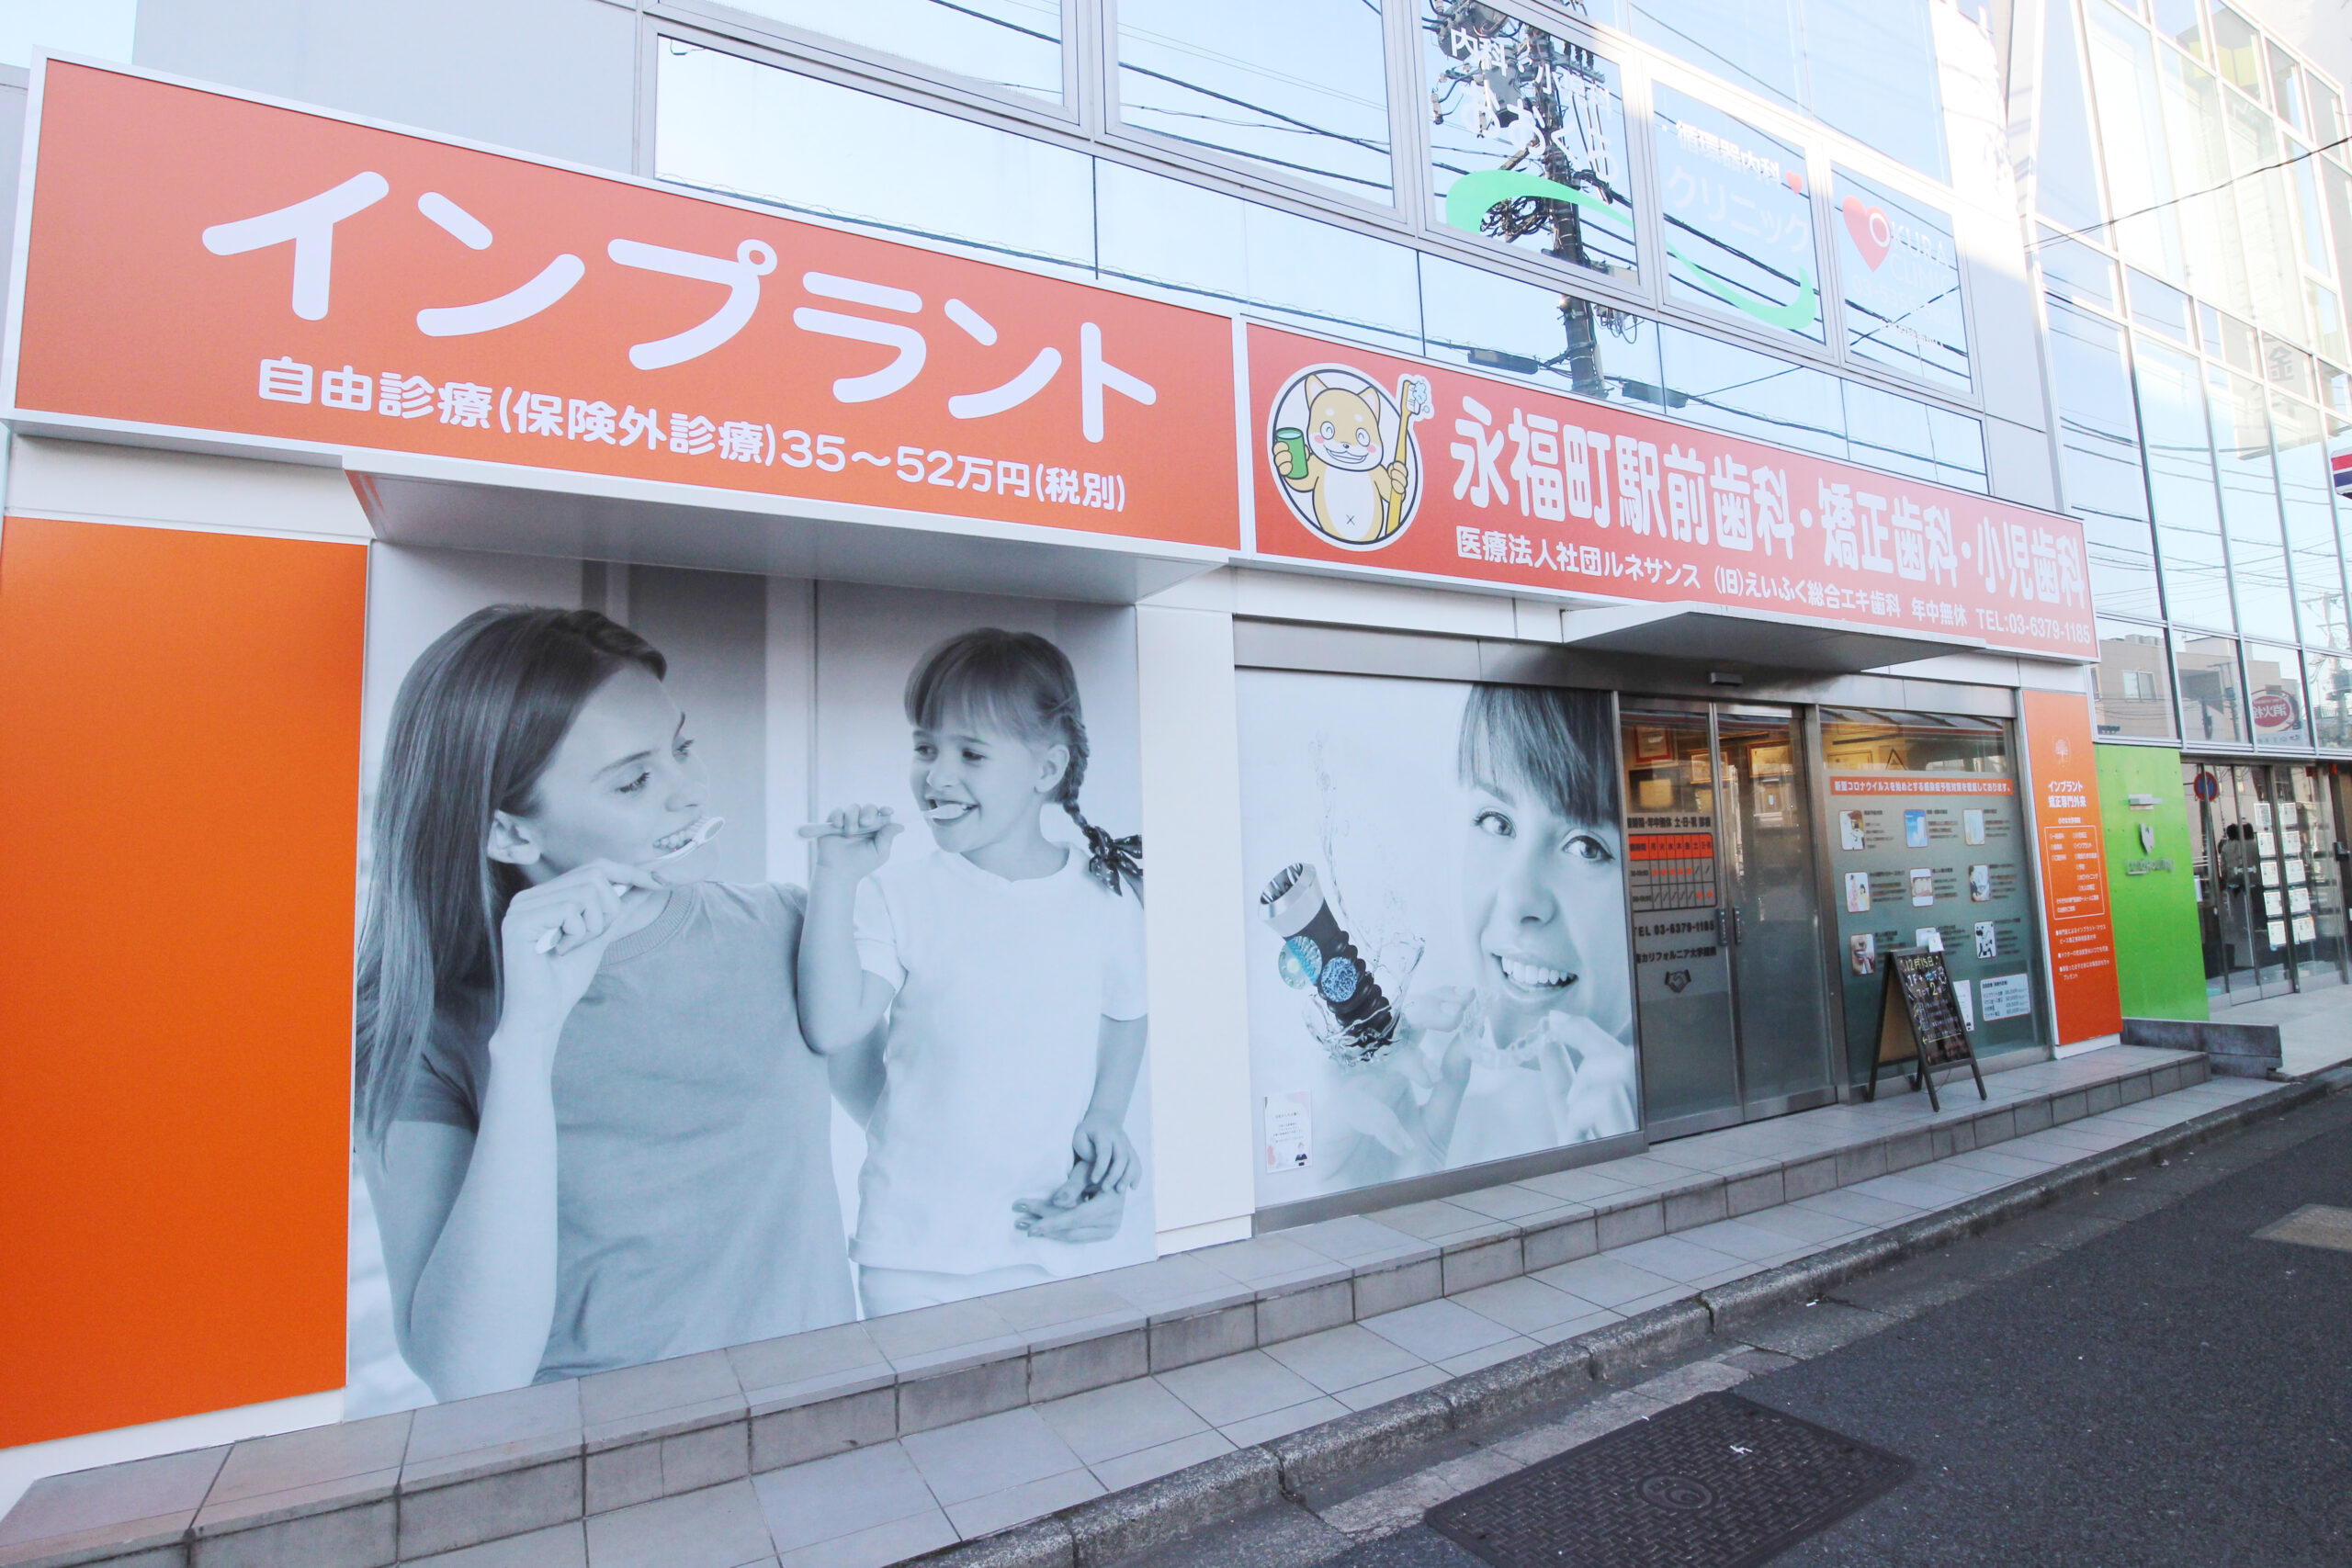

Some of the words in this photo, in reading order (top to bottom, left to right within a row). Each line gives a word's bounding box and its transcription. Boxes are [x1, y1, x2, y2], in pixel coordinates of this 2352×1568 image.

[1668, 164, 1810, 254] クリニック
[201, 170, 1157, 445] インプラント
[1449, 395, 2086, 610] 永福町駅前歯科・矯正歯科・小児歯科
[1454, 525, 1702, 591] 医療法人社団ルネサンス
[1714, 565, 1901, 618] (旧)えいふく総合エキ歯科
[1911, 597, 1968, 626] 年中無休
[1976, 607, 2091, 644] TEL:03-6379-1185
[2048, 781, 2083, 793] インプラント
